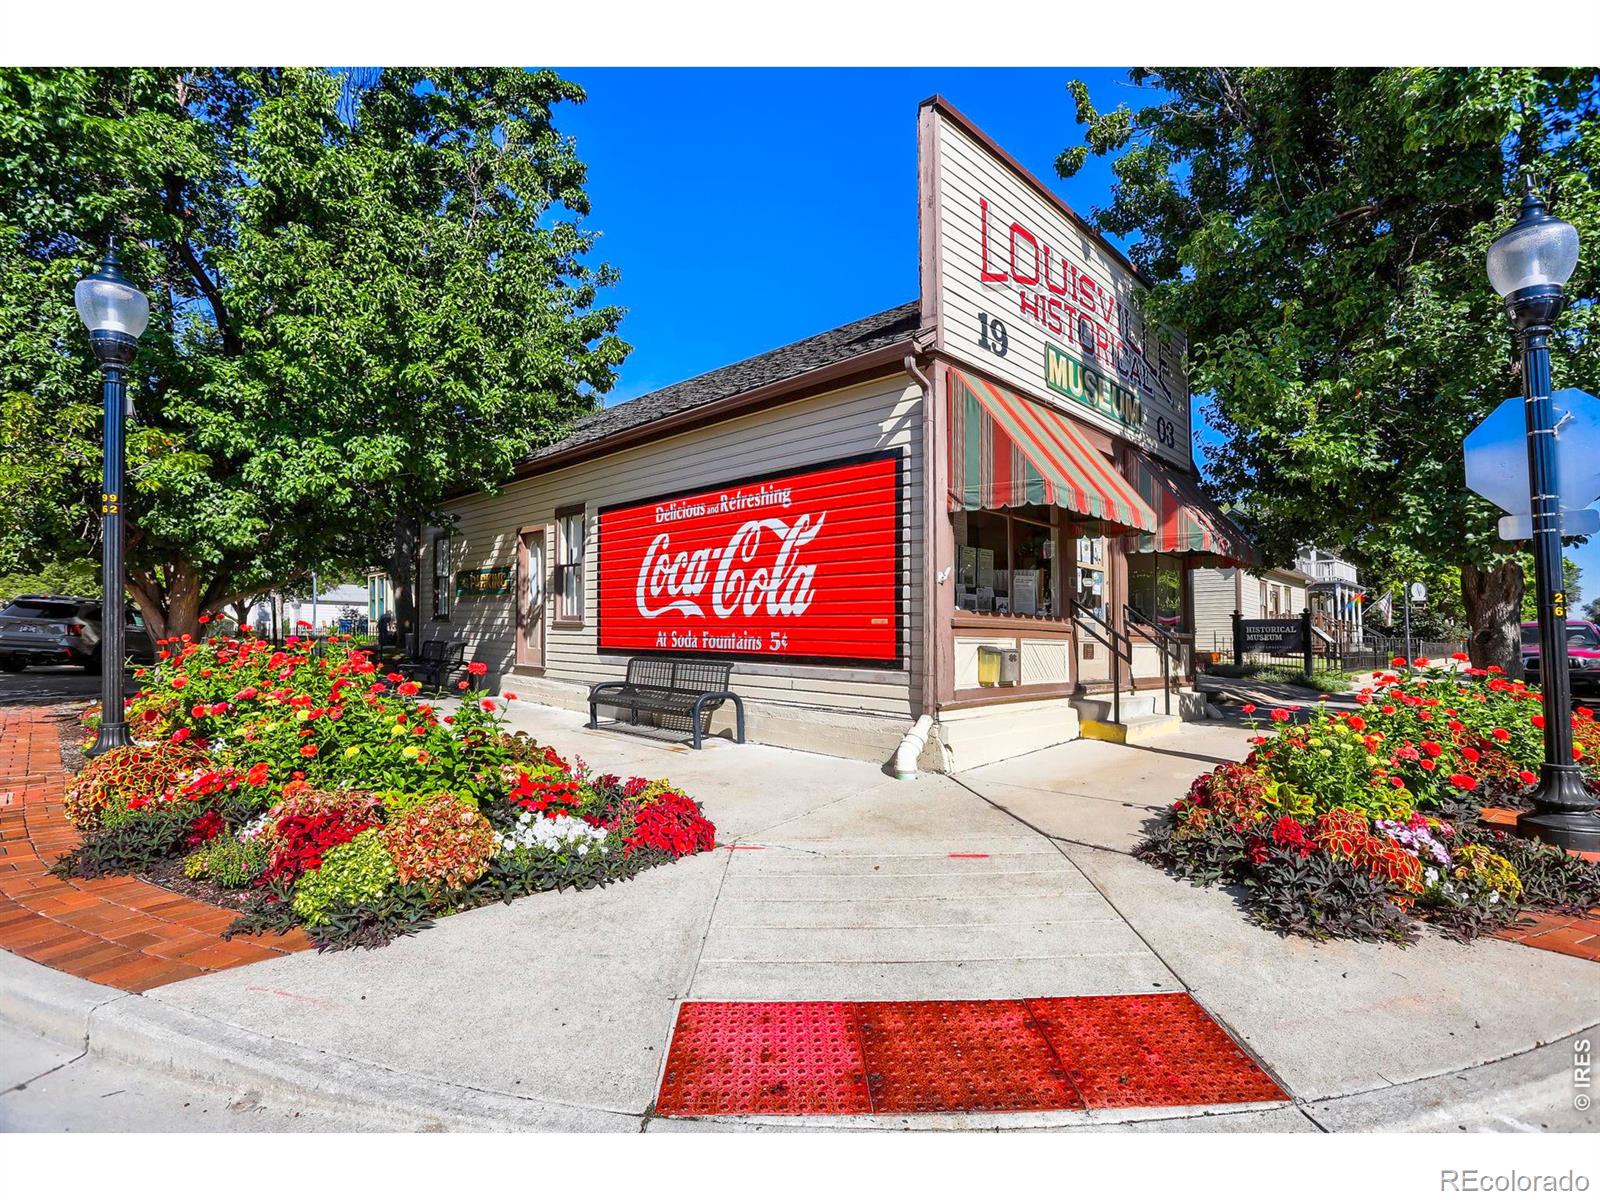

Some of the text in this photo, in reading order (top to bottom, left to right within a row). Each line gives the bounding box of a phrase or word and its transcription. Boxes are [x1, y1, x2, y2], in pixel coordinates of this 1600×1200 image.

[979, 197, 1173, 401] LOUISVILLE
[978, 312, 1009, 357] 19
[1018, 290, 1154, 394] HISTORICAL
[1048, 348, 1142, 428] MUSEUM
[1156, 416, 1176, 449] 03
[655, 484, 792, 523] Delicious and Refreshing
[656, 629, 789, 651] At Soda Fountains 5¢
[1246, 633, 1282, 641] MUSEUM
